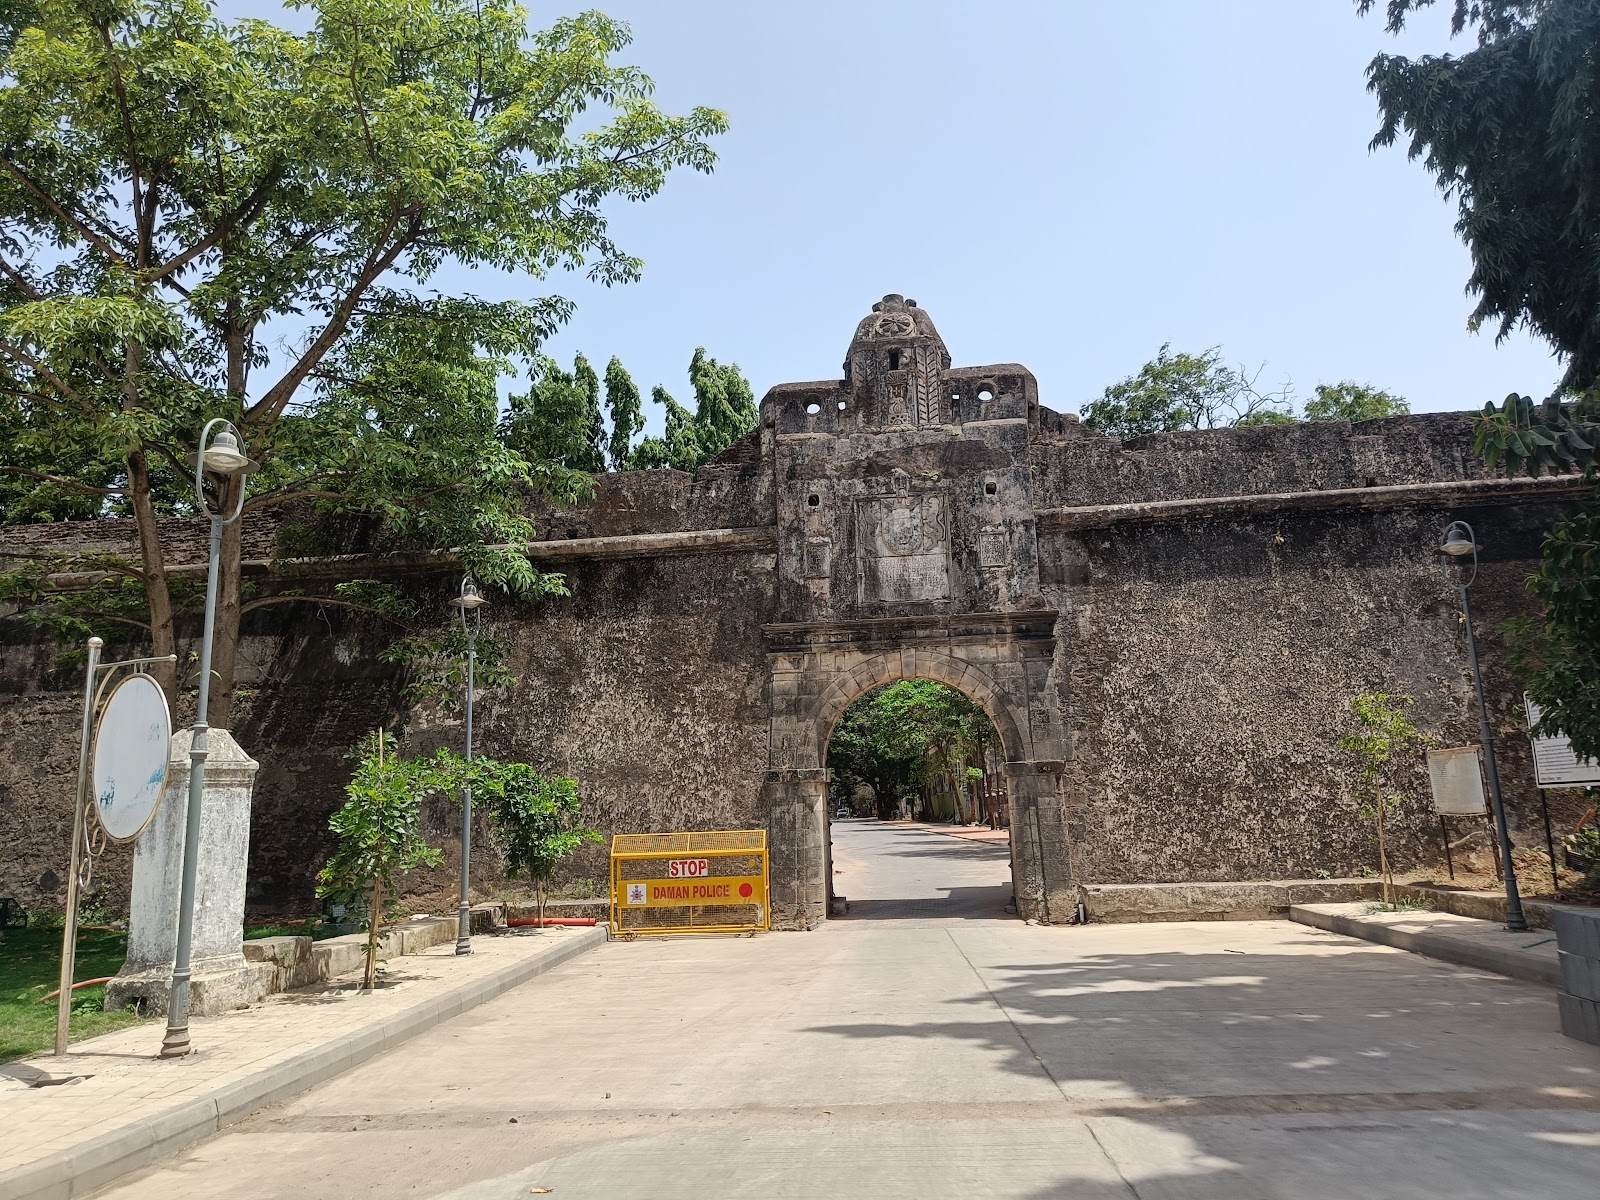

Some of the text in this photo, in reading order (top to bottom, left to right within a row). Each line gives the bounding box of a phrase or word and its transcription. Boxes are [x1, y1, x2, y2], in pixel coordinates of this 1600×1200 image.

[670, 860, 707, 876] STOP
[653, 884, 730, 899] DAMAN POLICE
